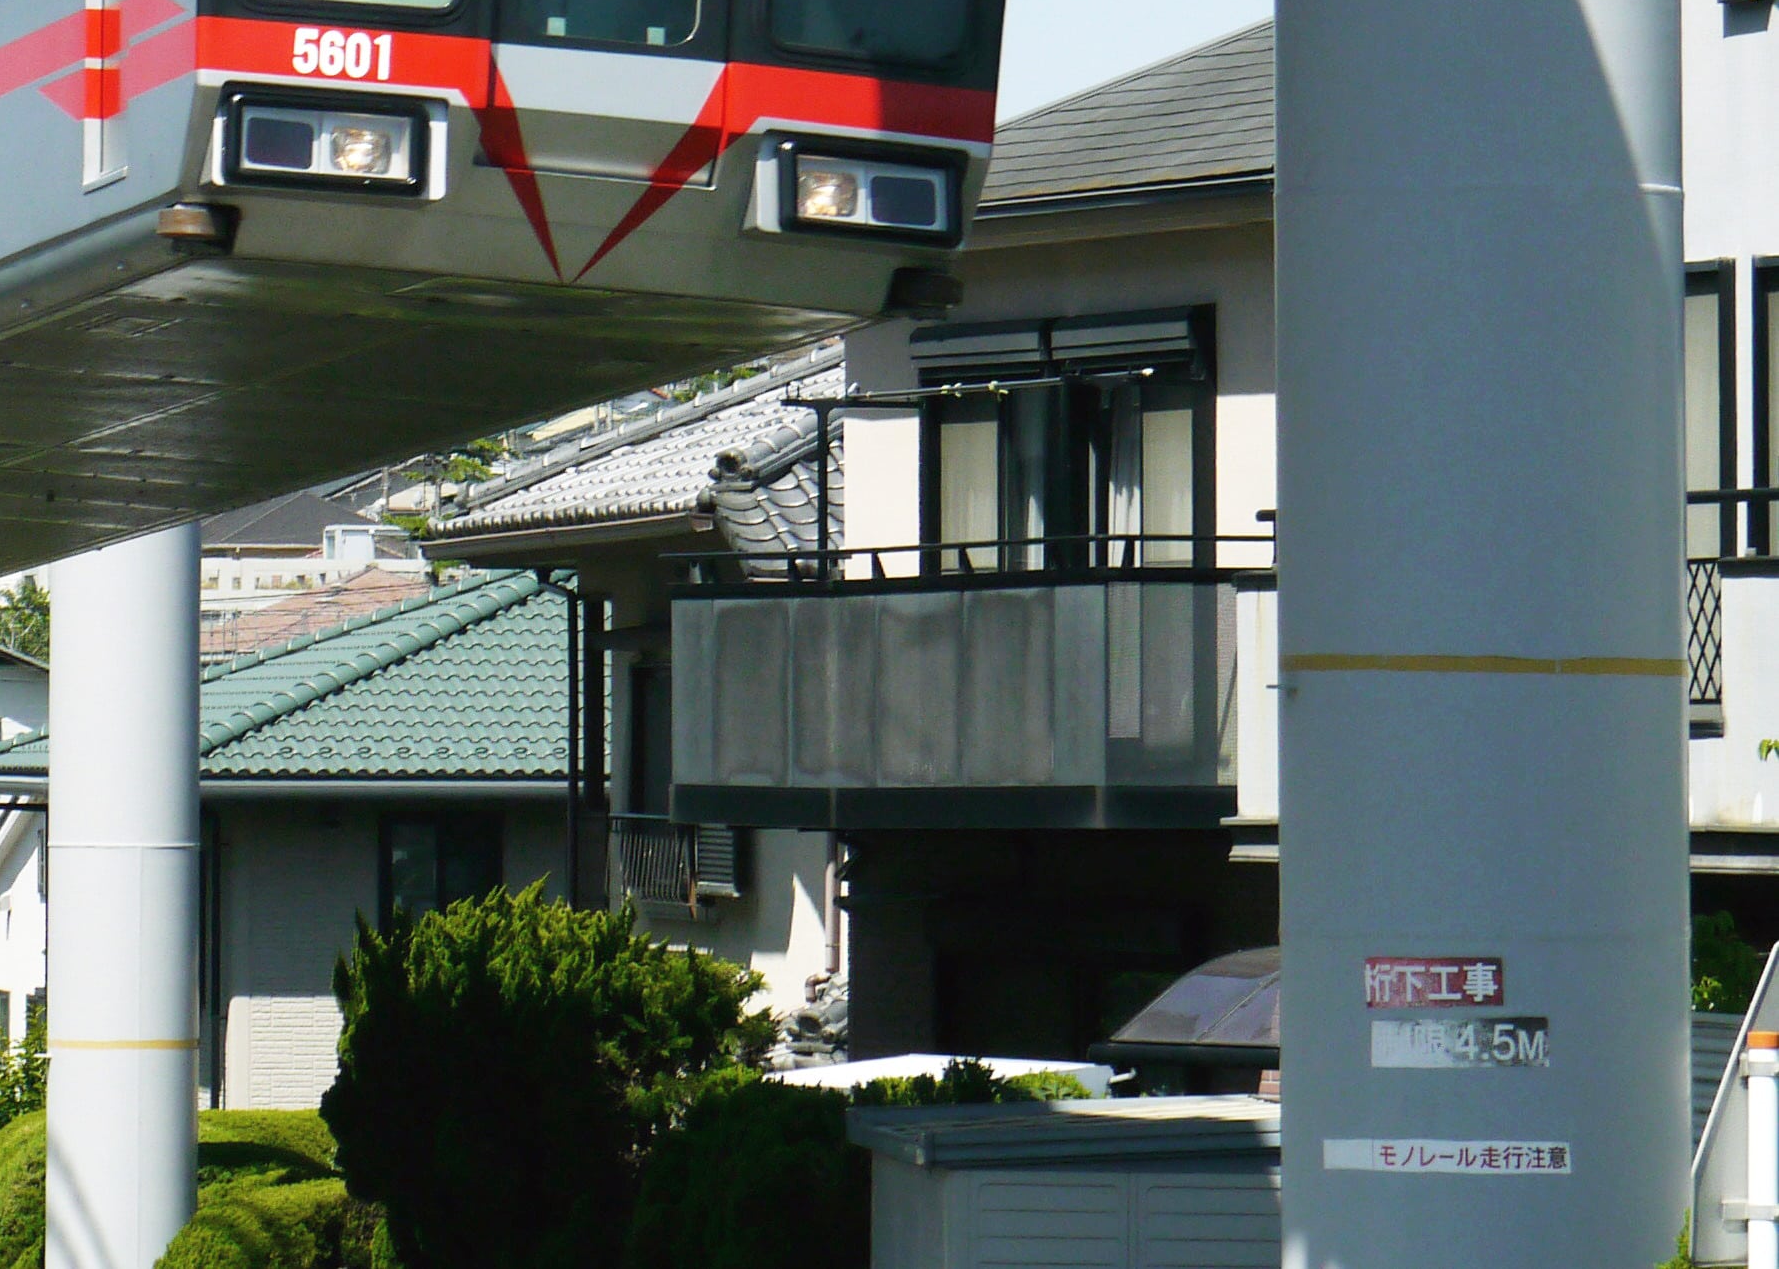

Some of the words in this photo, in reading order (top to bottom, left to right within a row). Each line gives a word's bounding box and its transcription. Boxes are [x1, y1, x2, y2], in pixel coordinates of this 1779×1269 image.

[292, 27, 392, 81] 5601
[1378, 1145, 1568, 1170] モノレール走行注意
